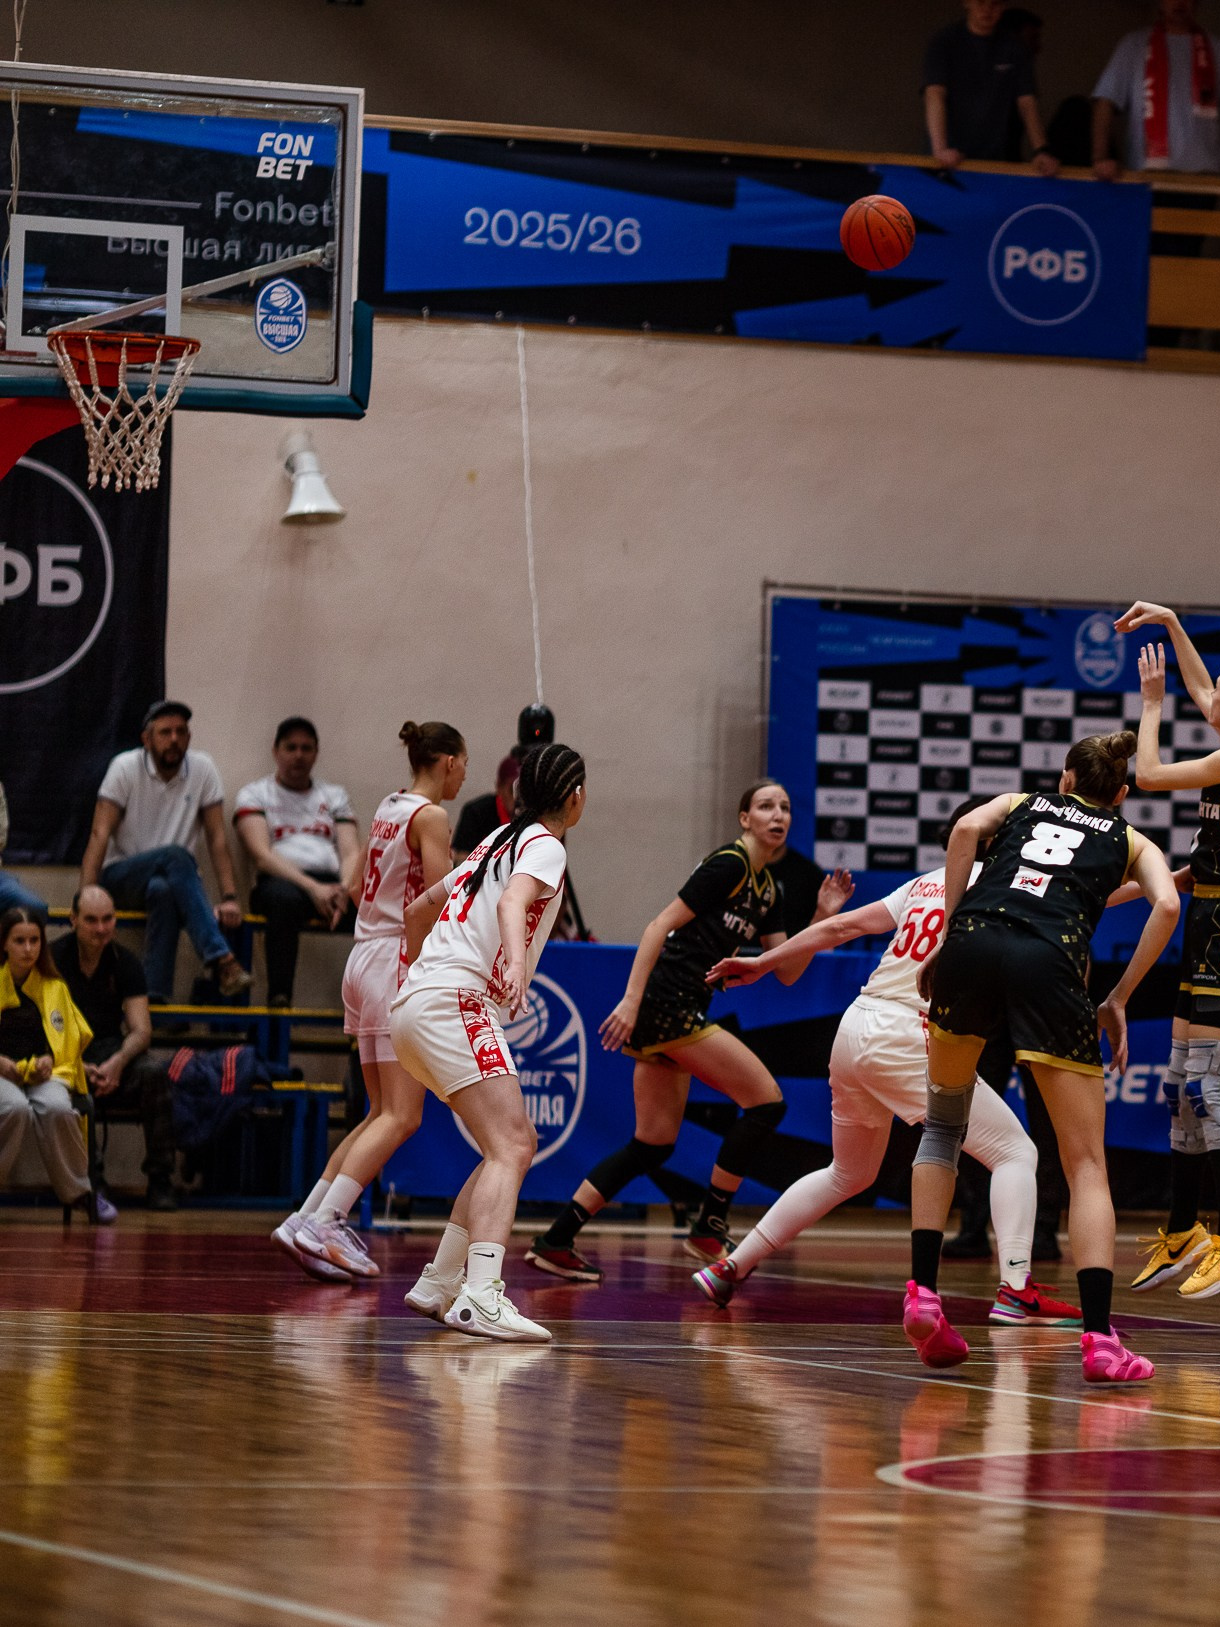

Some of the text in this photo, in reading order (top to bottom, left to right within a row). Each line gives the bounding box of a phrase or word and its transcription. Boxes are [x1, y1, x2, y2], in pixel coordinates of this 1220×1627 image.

[256, 132, 313, 156] FON
[255, 156, 313, 181] BET
[214, 191, 334, 227] Fonbet
[463, 207, 642, 256] 2025/26
[1003, 246, 1088, 284] РФБ
[1020, 822, 1086, 866] 8
[892, 907, 945, 963] 58
[1104, 1063, 1168, 1105] BET
